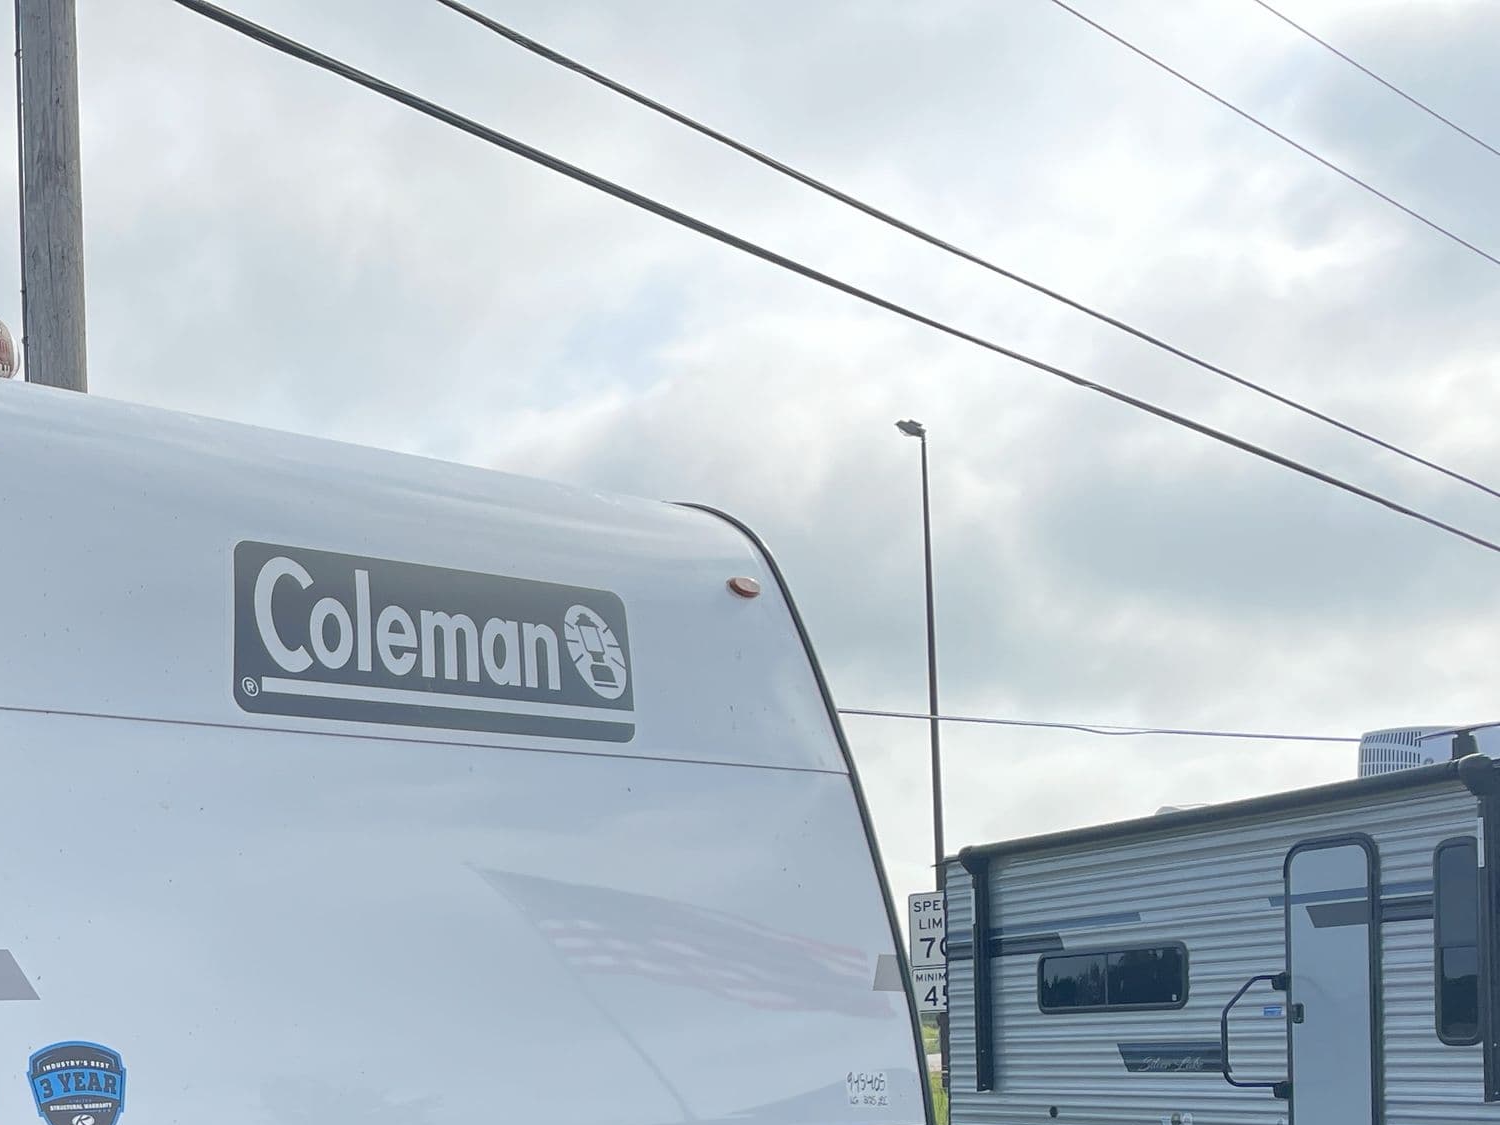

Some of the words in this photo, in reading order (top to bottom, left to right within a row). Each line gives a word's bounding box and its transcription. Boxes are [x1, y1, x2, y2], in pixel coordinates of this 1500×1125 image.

[254, 556, 561, 691] Coleman
[913, 900, 947, 912] SPE
[919, 918, 943, 930] LIM
[42, 1059, 88, 1072] INDUSTRY'S
[90, 1060, 110, 1069] BEST
[41, 1078, 54, 1099] 3
[57, 1071, 117, 1095] YEAR
